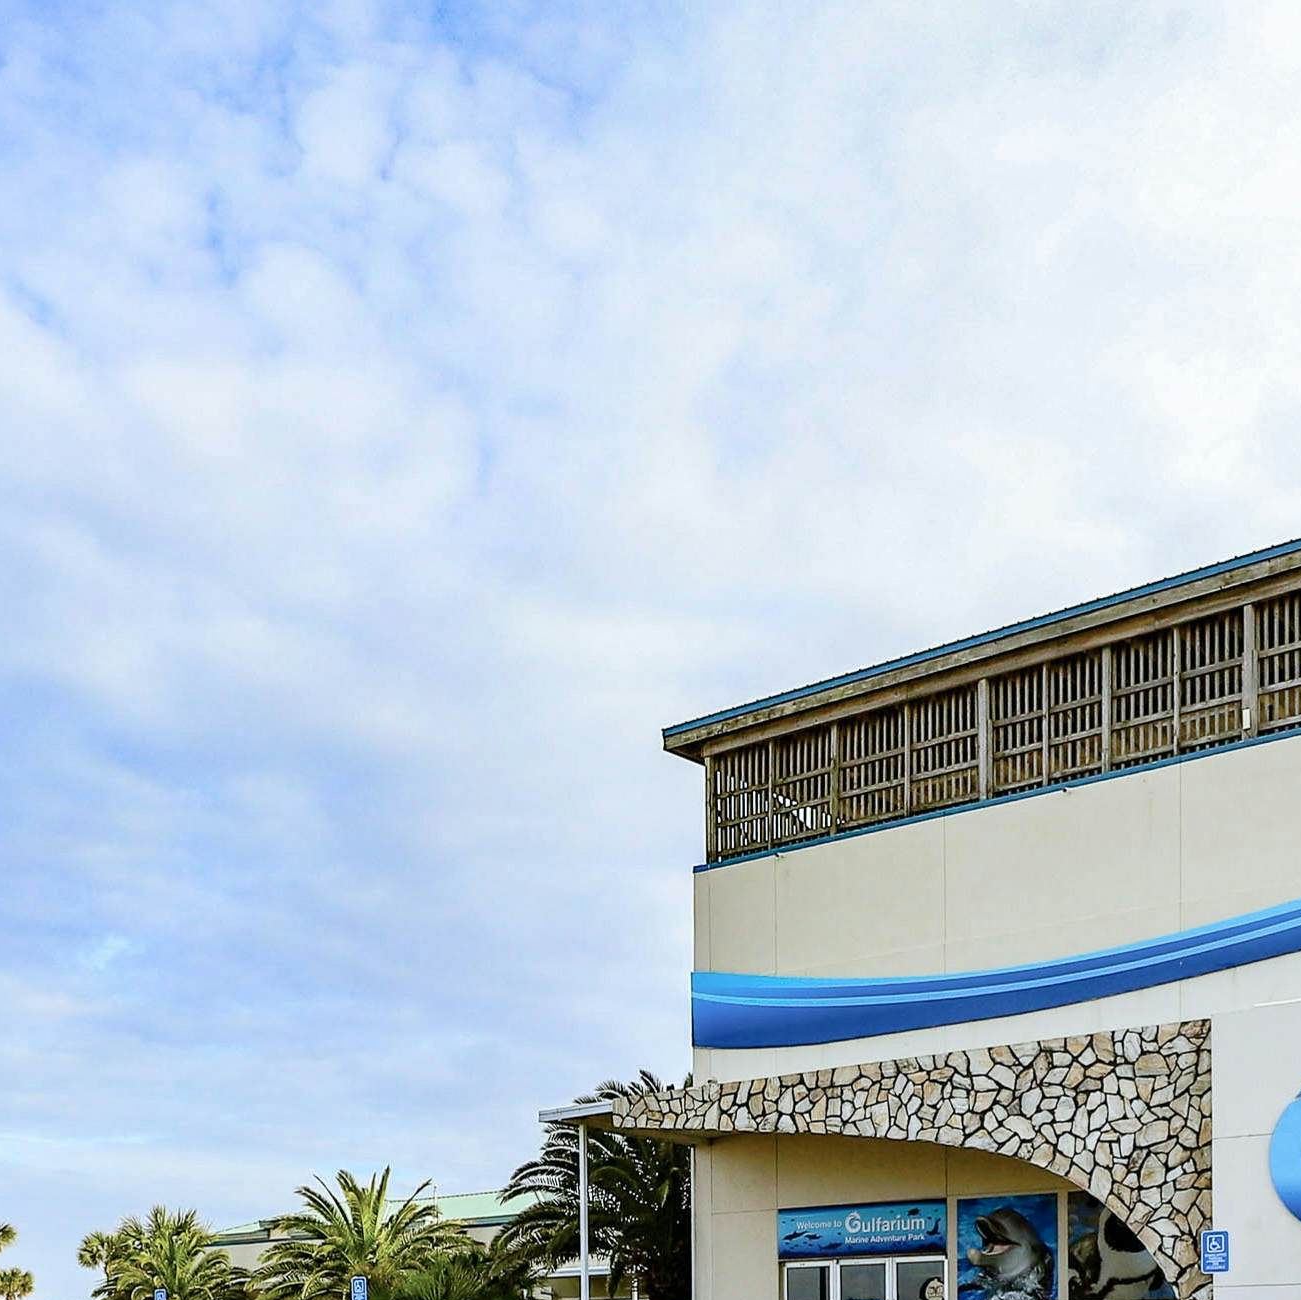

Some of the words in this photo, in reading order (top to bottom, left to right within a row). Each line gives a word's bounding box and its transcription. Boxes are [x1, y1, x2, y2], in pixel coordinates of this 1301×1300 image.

[796, 1220, 832, 1230] Welcome
[833, 1219, 842, 1228] to
[844, 1210, 925, 1233] Gulfarium
[845, 1236, 869, 1244] Marine
[870, 1234, 906, 1243] Adventure
[908, 1233, 925, 1241] Park
